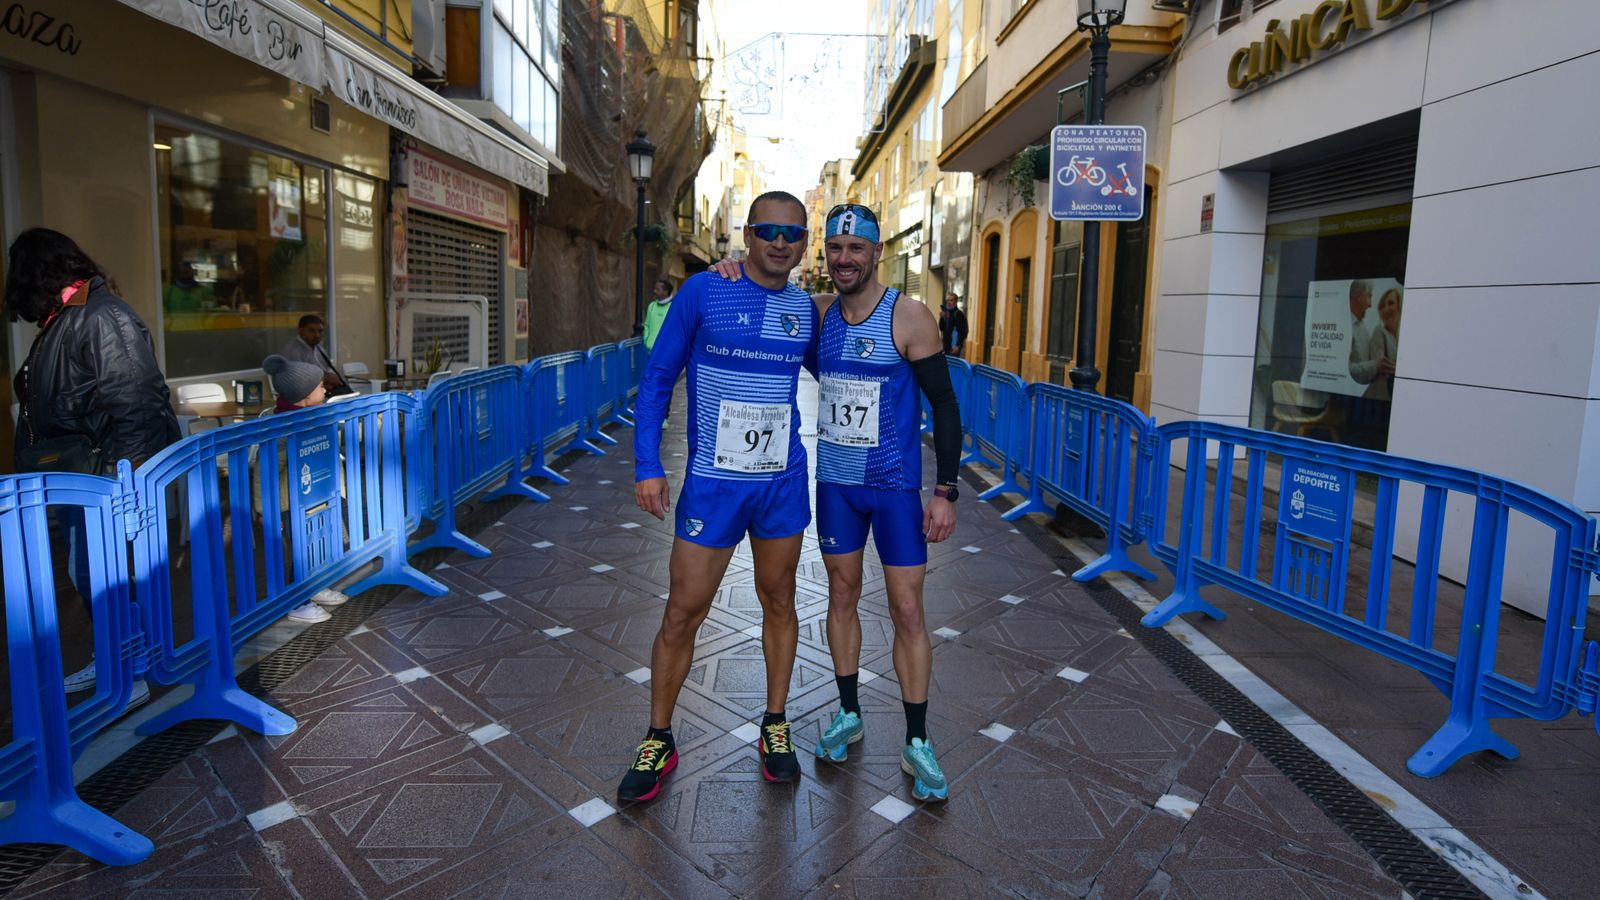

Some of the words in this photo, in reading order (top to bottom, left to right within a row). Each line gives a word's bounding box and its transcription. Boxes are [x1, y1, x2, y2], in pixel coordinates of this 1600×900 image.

[187, 0, 251, 38] Café
[267, 20, 303, 61] Bar
[1227, 0, 1372, 89] CLÍNICA
[413, 159, 440, 184] SALÓN
[440, 168, 451, 187] DE
[471, 181, 481, 199] DE
[445, 188, 465, 212] ROSA
[1071, 202, 1103, 211] SANCIÓN
[1311, 323, 1337, 331] INVIERTE
[1319, 332, 1344, 341] CALIDAD
[706, 344, 729, 356] Club
[731, 348, 783, 362] Atletismo
[829, 371, 860, 381] Atletismo
[860, 374, 890, 383] Linense
[830, 403, 869, 429] 137
[299, 440, 330, 458] DEPORTES
[744, 429, 774, 453] 97
[1293, 473, 1341, 493] DEPORTES
[1297, 467, 1329, 480] DELEGACIÓN
